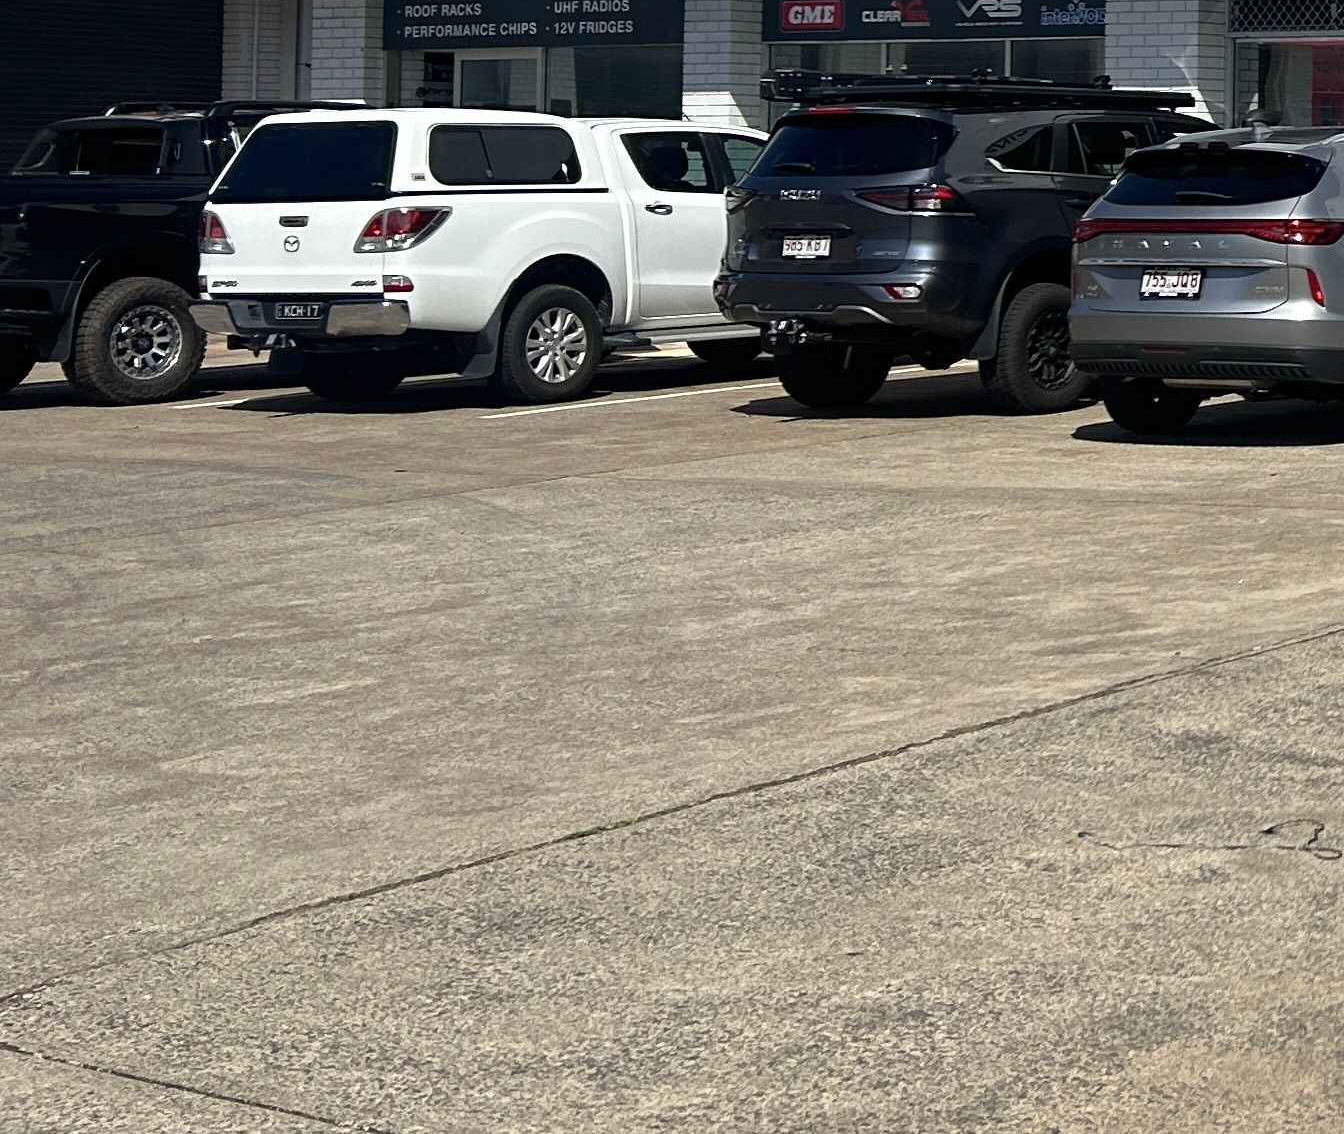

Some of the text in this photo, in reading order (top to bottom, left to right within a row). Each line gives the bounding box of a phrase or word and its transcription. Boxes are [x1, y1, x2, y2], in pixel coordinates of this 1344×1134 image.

[405, 4, 482, 17] ROOF RACKS
[554, 0, 630, 14] UHF RADIOS
[788, 5, 835, 25] GME
[404, 22, 537, 38] PERFORMANCE CHIPS
[553, 21, 634, 35] 12V FRIDGES
